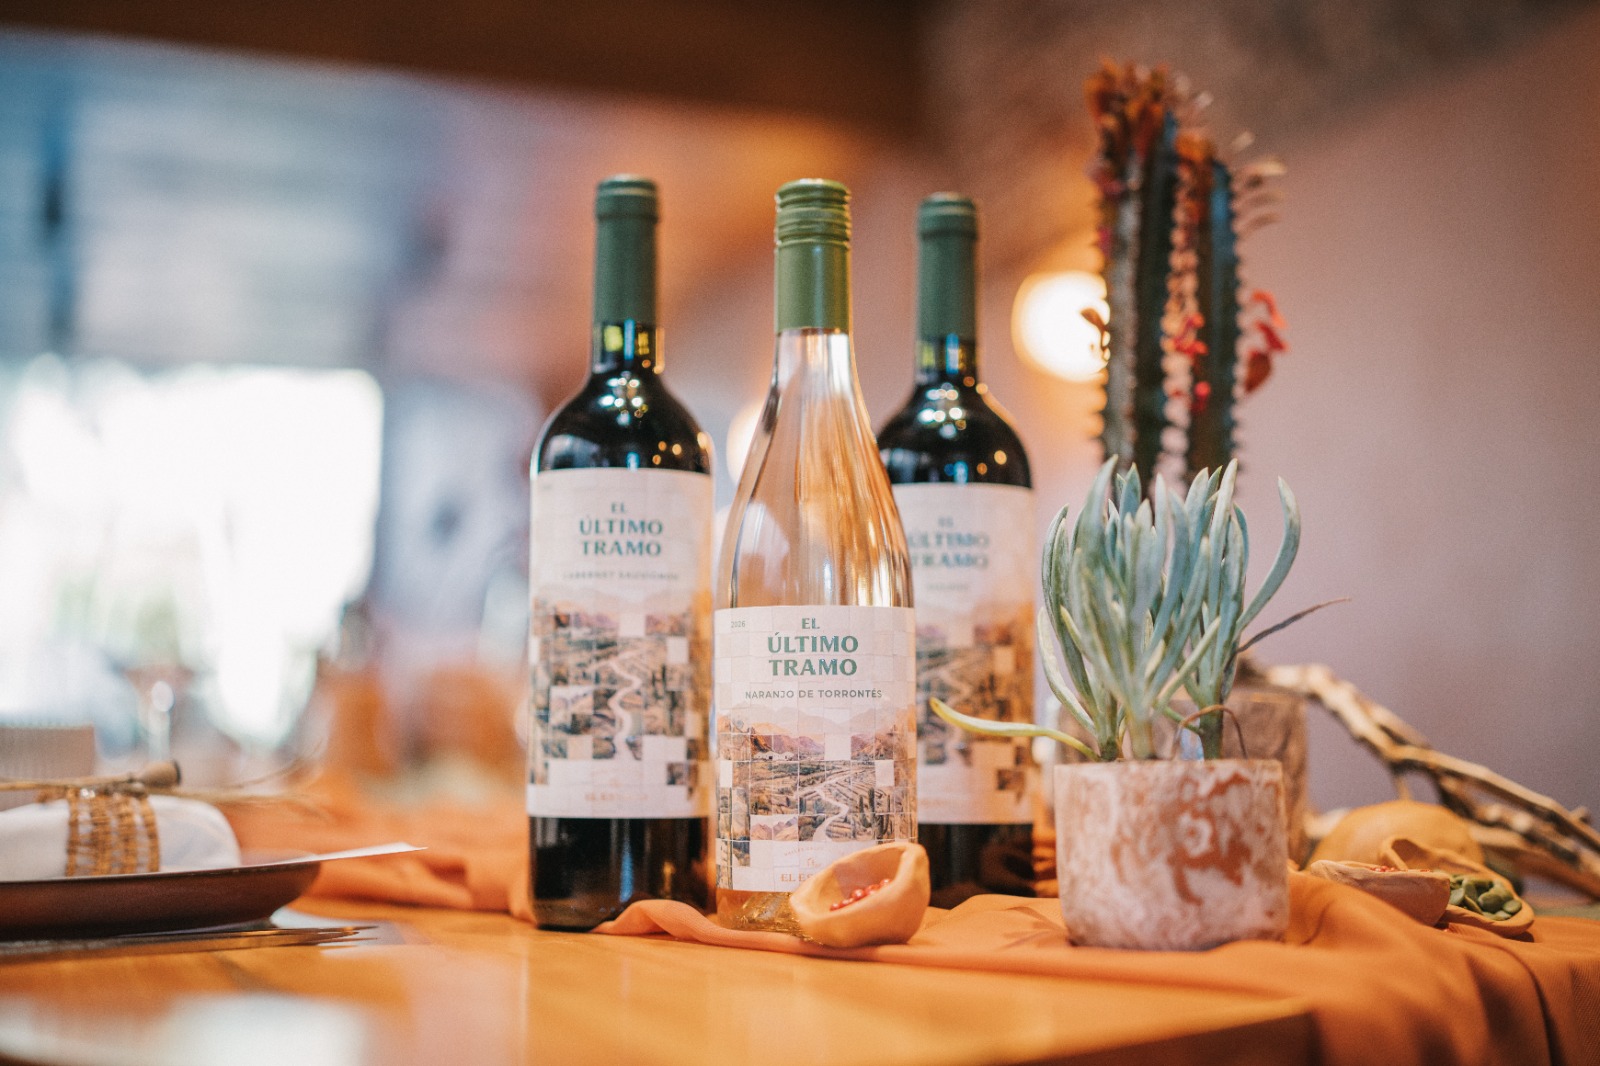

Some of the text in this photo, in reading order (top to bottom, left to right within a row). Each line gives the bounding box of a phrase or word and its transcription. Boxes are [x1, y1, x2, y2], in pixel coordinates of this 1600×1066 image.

[611, 502, 627, 513] EL
[579, 515, 664, 535] ÚLTIMO
[581, 540, 662, 556] TRAMO
[801, 617, 820, 630] EL
[767, 632, 859, 653] ÚLTIMO
[768, 658, 857, 676] TRAMO
[745, 688, 883, 699] NARANJO DE TORRONTÉS
[780, 873, 797, 882] EL
